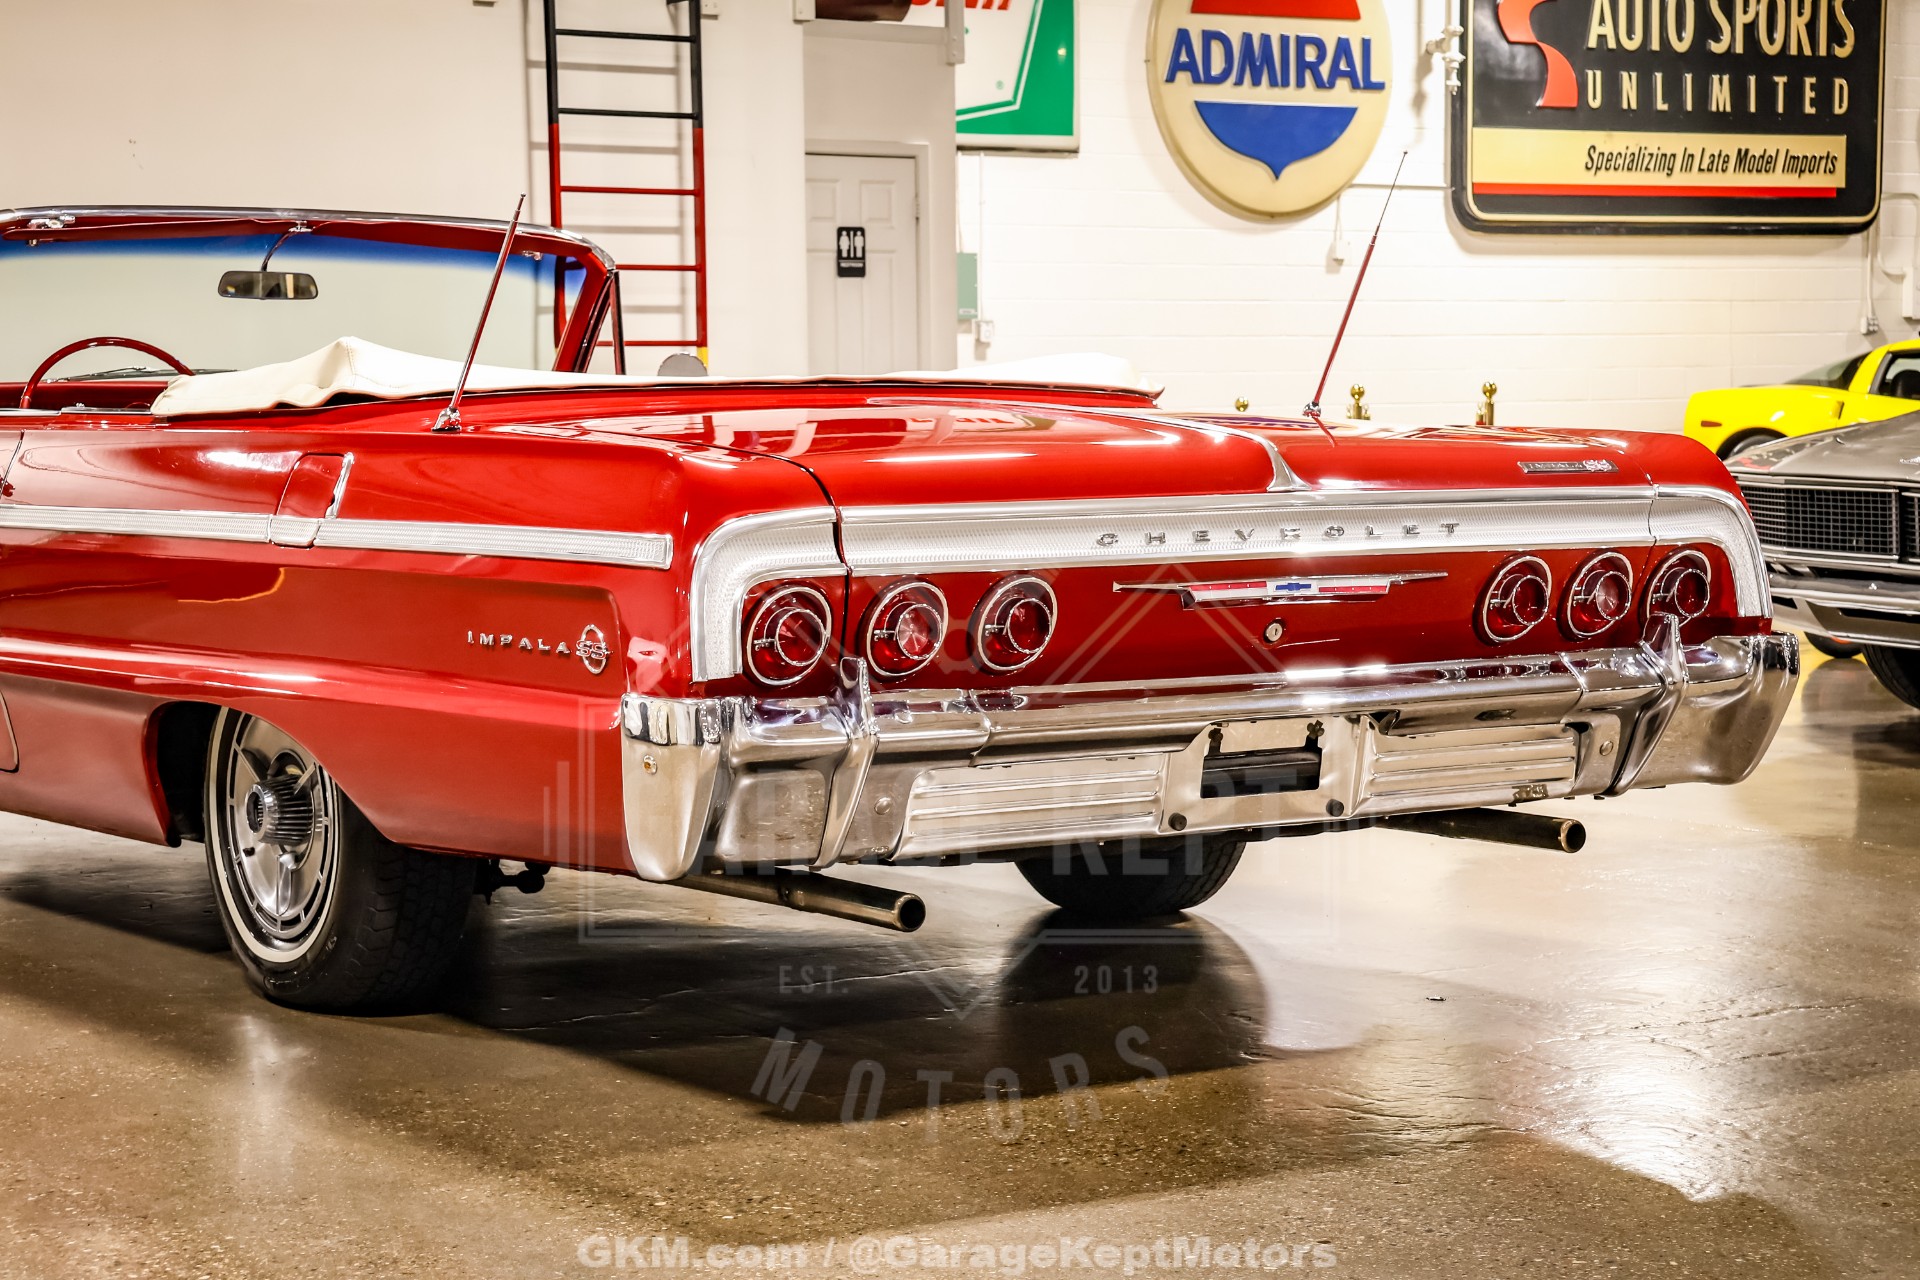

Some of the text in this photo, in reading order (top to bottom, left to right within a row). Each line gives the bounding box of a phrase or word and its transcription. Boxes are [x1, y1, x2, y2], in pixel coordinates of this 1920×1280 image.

[1586, 0, 1856, 58] AUTO SPORTS
[1165, 28, 1386, 91] ADMIRAL
[1585, 69, 1850, 116] UNLIMITED
[1584, 145, 1839, 178] Specializing In Late Model Imports
[1096, 522, 1461, 547] CHEVROLET
[467, 630, 572, 655] IMPALA
